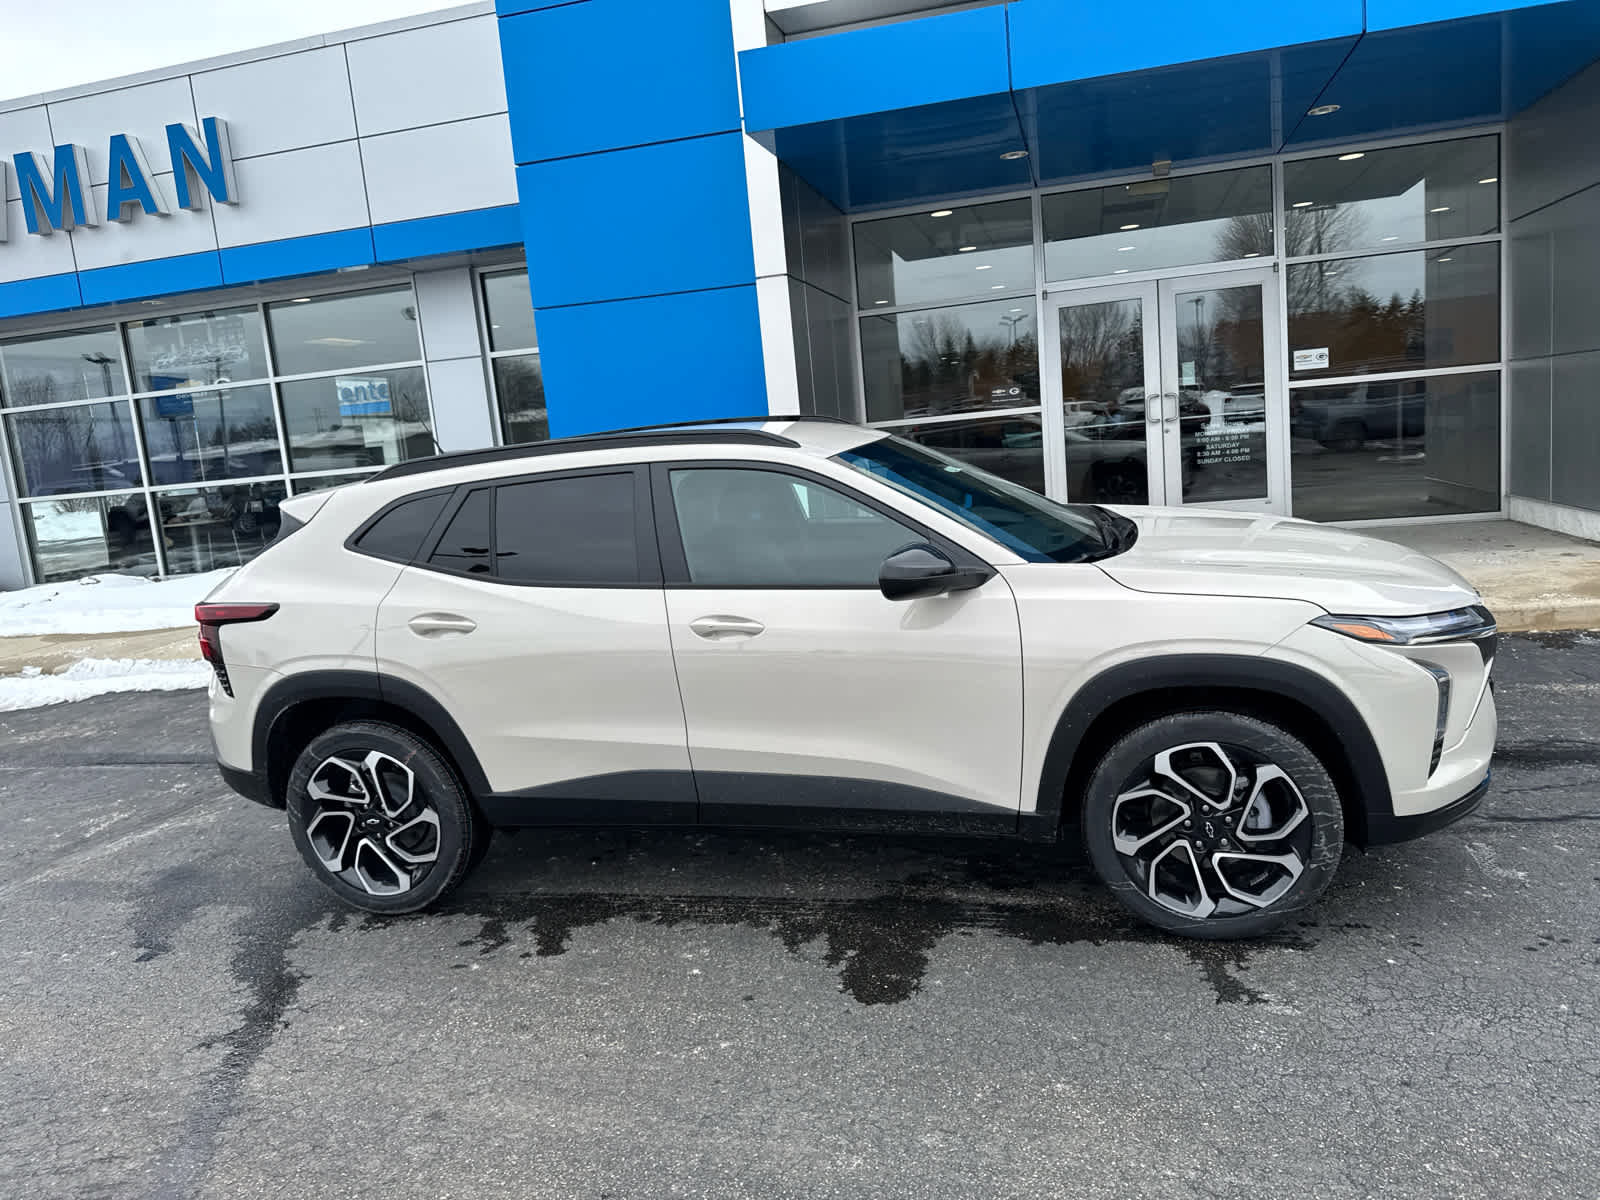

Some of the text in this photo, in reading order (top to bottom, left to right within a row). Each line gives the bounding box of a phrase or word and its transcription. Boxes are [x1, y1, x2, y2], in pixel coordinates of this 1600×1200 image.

[0, 116, 236, 242] MAN
[1206, 441, 1240, 450] SATURDAY
[1224, 455, 1250, 463] CLOSED
